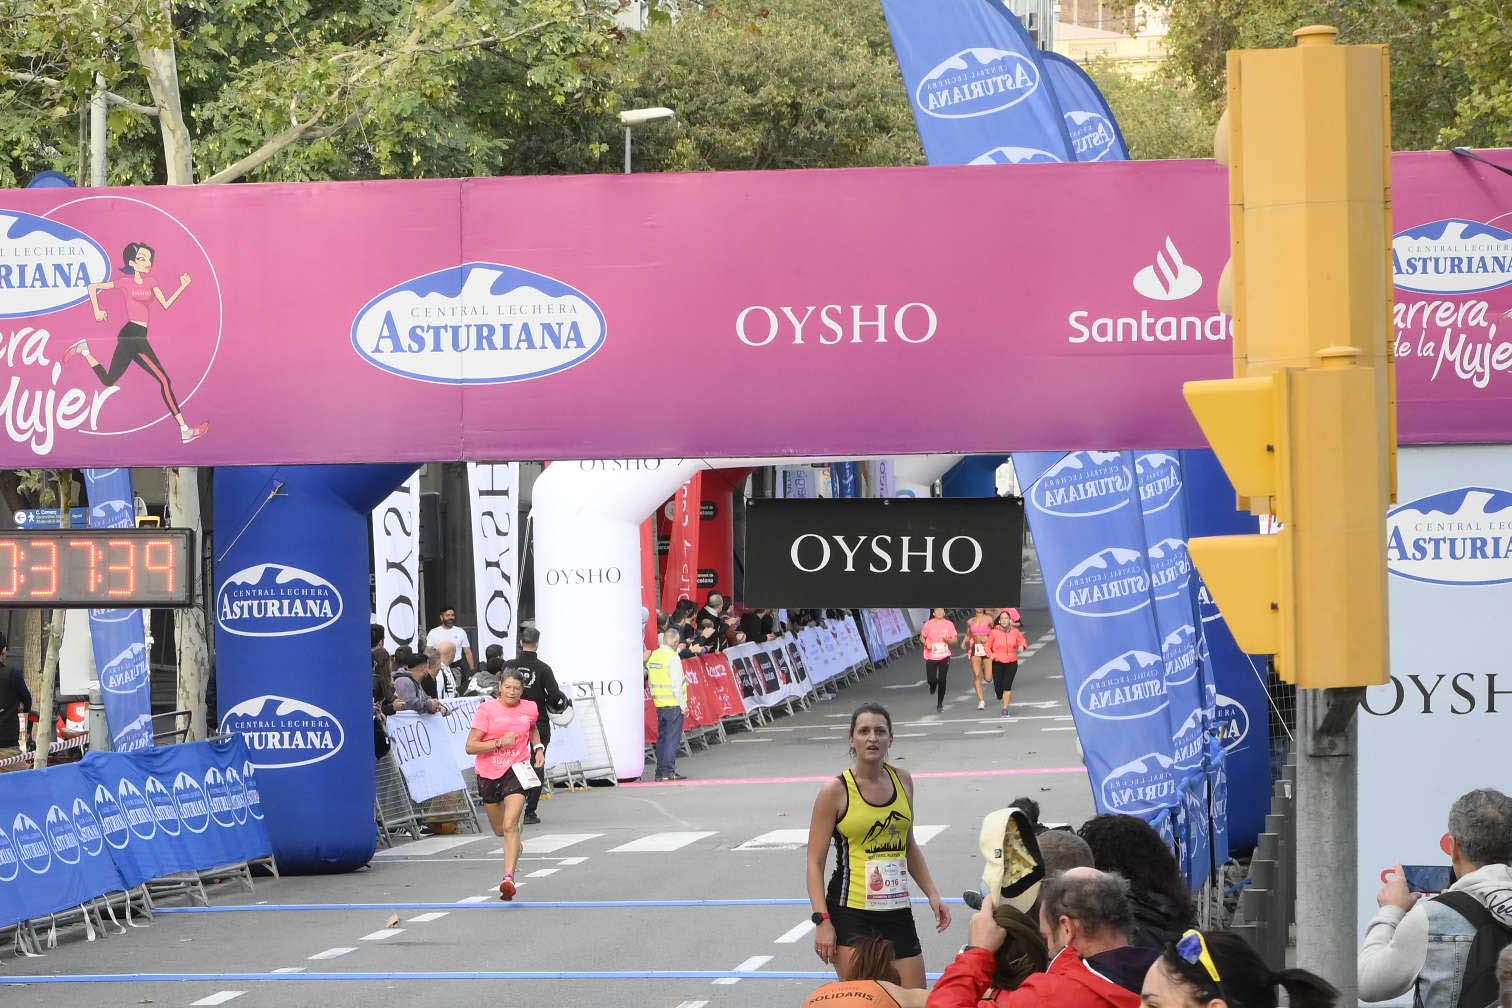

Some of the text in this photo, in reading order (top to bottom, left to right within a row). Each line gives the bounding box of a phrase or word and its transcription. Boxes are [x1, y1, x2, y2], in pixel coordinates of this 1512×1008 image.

[14, 245, 86, 257] LECHERA
[410, 302, 579, 319] CENTRAL LECHERA
[1393, 300, 1489, 328] arrera
[371, 310, 587, 354] ASTURIANA
[735, 302, 938, 346] OYSHO
[1418, 329, 1435, 357] la
[1430, 324, 1512, 389] Muje
[1415, 523, 1481, 532] CENTRAL
[790, 533, 983, 574] OYSHO
[546, 567, 621, 586] OYSHO
[233, 588, 329, 597] CENTRAL LECHERA
[221, 594, 333, 621] ASTURIANA
[281, 719, 330, 728] LECHERA
